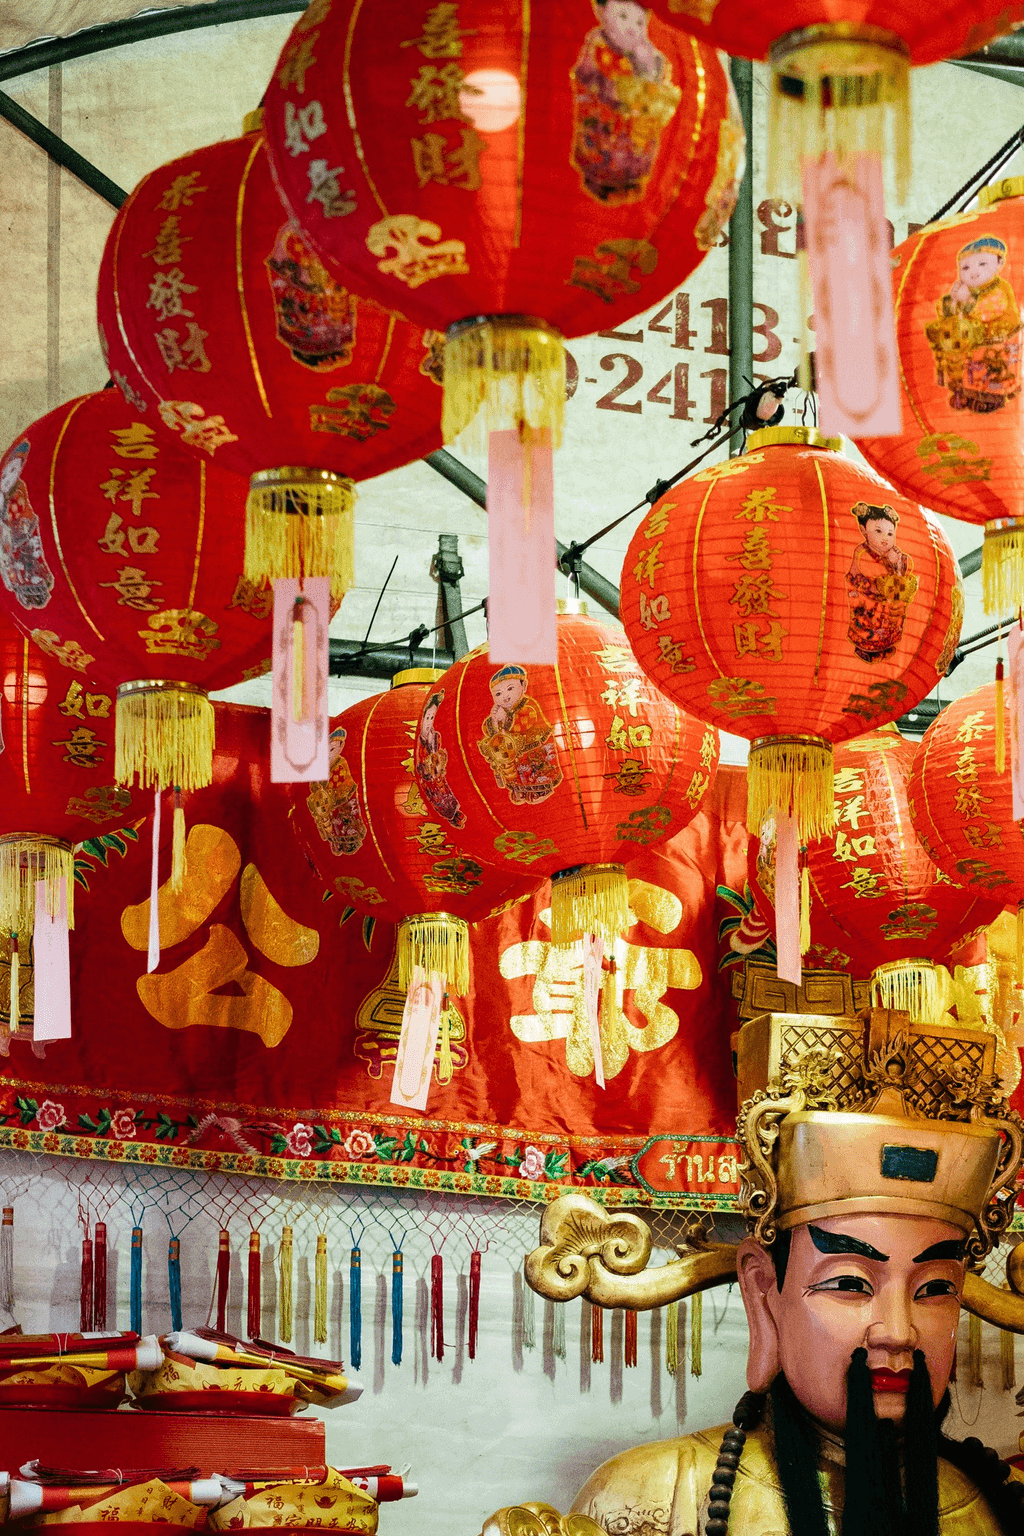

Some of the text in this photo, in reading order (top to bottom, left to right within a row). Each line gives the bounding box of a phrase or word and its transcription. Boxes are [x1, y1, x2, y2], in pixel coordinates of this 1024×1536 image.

[142, 171, 212, 373] 恭喜發財
[98, 421, 165, 612] 吉祥如意
[632, 502, 696, 676] 吉祥如意
[727, 486, 794, 662] 恭喜發財
[591, 642, 653, 796] 吉祥如意
[946, 710, 1004, 851] 恭喜發財
[833, 767, 886, 899] 吉祥如意
